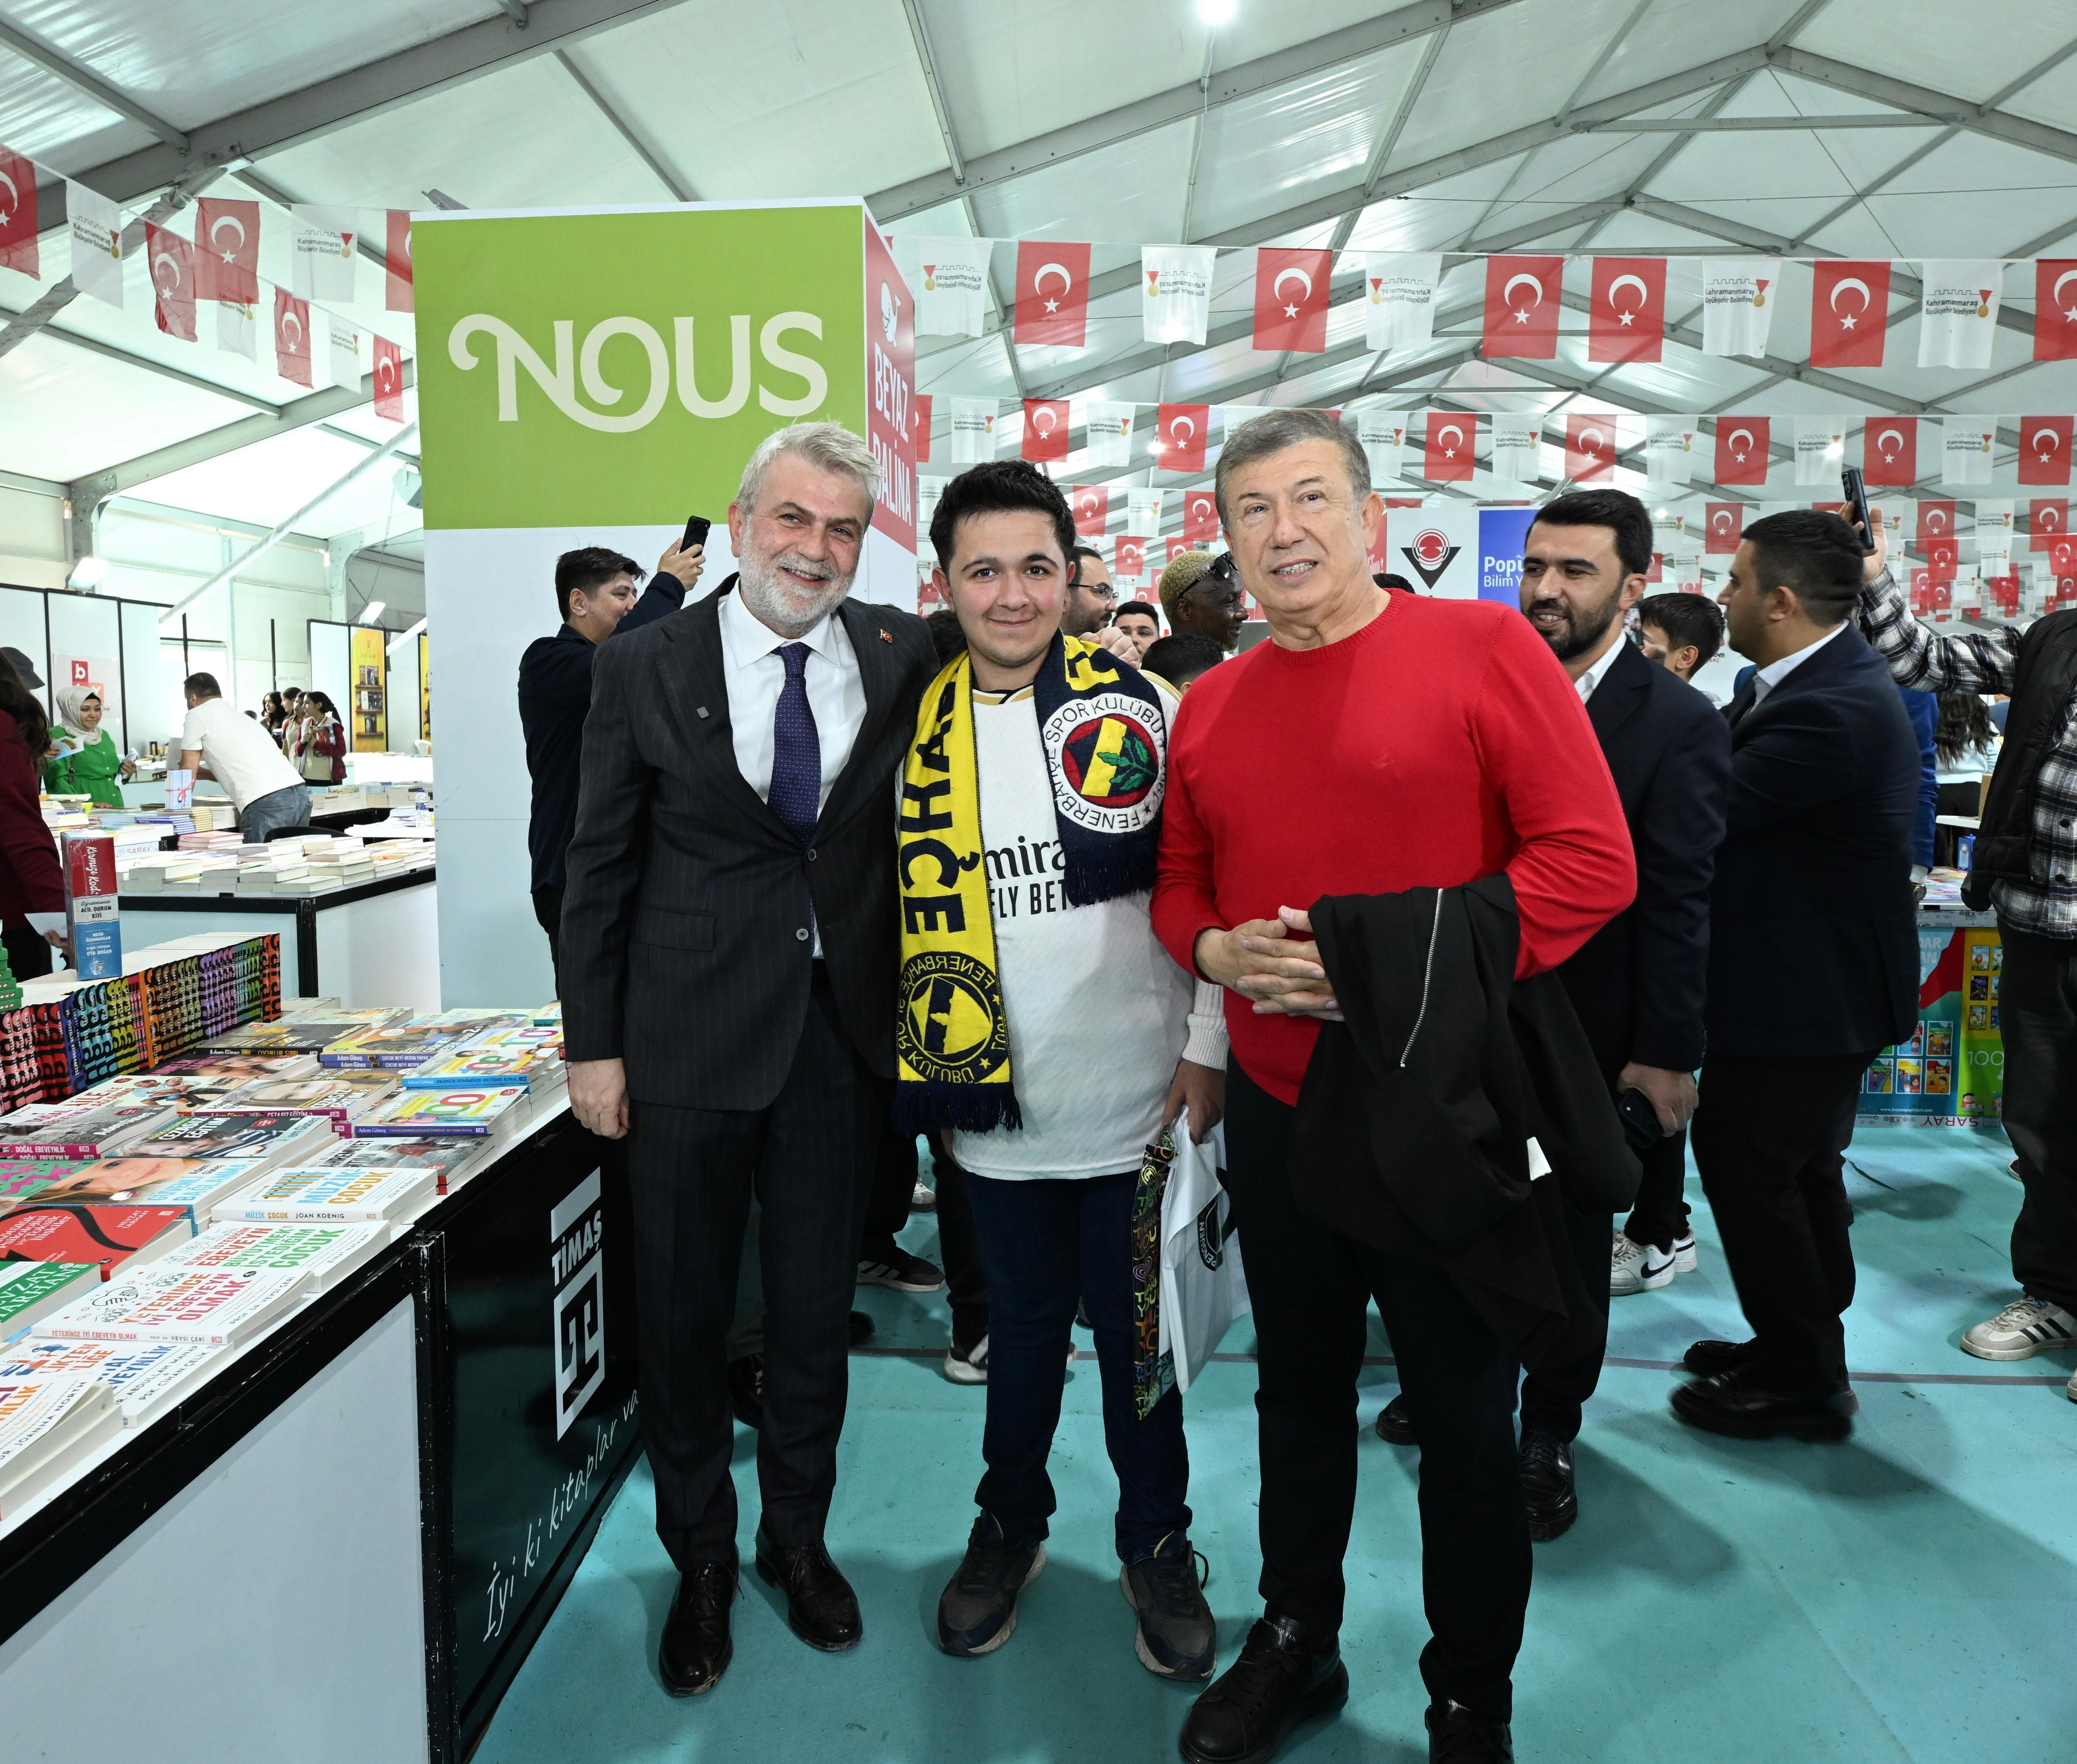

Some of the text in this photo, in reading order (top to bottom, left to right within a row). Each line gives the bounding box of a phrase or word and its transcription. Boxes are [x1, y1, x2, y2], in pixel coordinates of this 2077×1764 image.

[448, 311, 828, 433] NOUS
[875, 342, 908, 443] BEYAZ
[872, 432, 912, 526] BALİNA
[1484, 574, 1523, 587] Bilim Y
[1046, 703, 1090, 742] SPOR
[86, 846, 101, 895] Kırmızı Kod:
[985, 835, 1066, 881] mira
[1030, 879, 1067, 915] BET
[158, 1117, 209, 1141] CEZASIZ
[184, 1118, 231, 1138] EĞİTİM
[1923, 1116, 1979, 1127] SARAY
[16, 1144, 65, 1153] DOĞAL EBEVEYNLİK
[171, 1163, 248, 1201] BAĞLANMA
[296, 1168, 367, 1203] MÜZİK
[328, 1172, 394, 1204] ÇOCUK
[15, 1216, 61, 1246] ve Toksik
[29, 1215, 73, 1241] İlişkiler
[116, 1210, 142, 1228] NEVZAT
[122, 1210, 150, 1230] TARHAN
[245, 1211, 265, 1219] MÜZİK
[183, 1250, 213, 1266] OLMAK
[196, 1228, 274, 1266] EBEVEYN
[222, 1229, 293, 1267] BÜYÜTMEK
[245, 1229, 316, 1268] İSTEDİĞİM
[268, 1229, 347, 1268] ÇOCUK
[551, 1209, 602, 1287] TİMAŞ
[118, 1273, 212, 1324] YETERİNCE
[138, 1274, 234, 1326] İYİ EBEVEYN
[175, 1280, 251, 1321] OLMAK
[262, 1276, 297, 1303] VEYSİ ÇERİ
[127, 1345, 199, 1396] ABDULLAH MANAP
[158, 1367, 183, 1387] CİHAN
[183, 1352, 211, 1368] ÇELİK
[15, 1414, 56, 1446] JOANNA
[54, 1382, 87, 1411] NORTH
[483, 1389, 639, 1642] İyi ki kitaplar va
